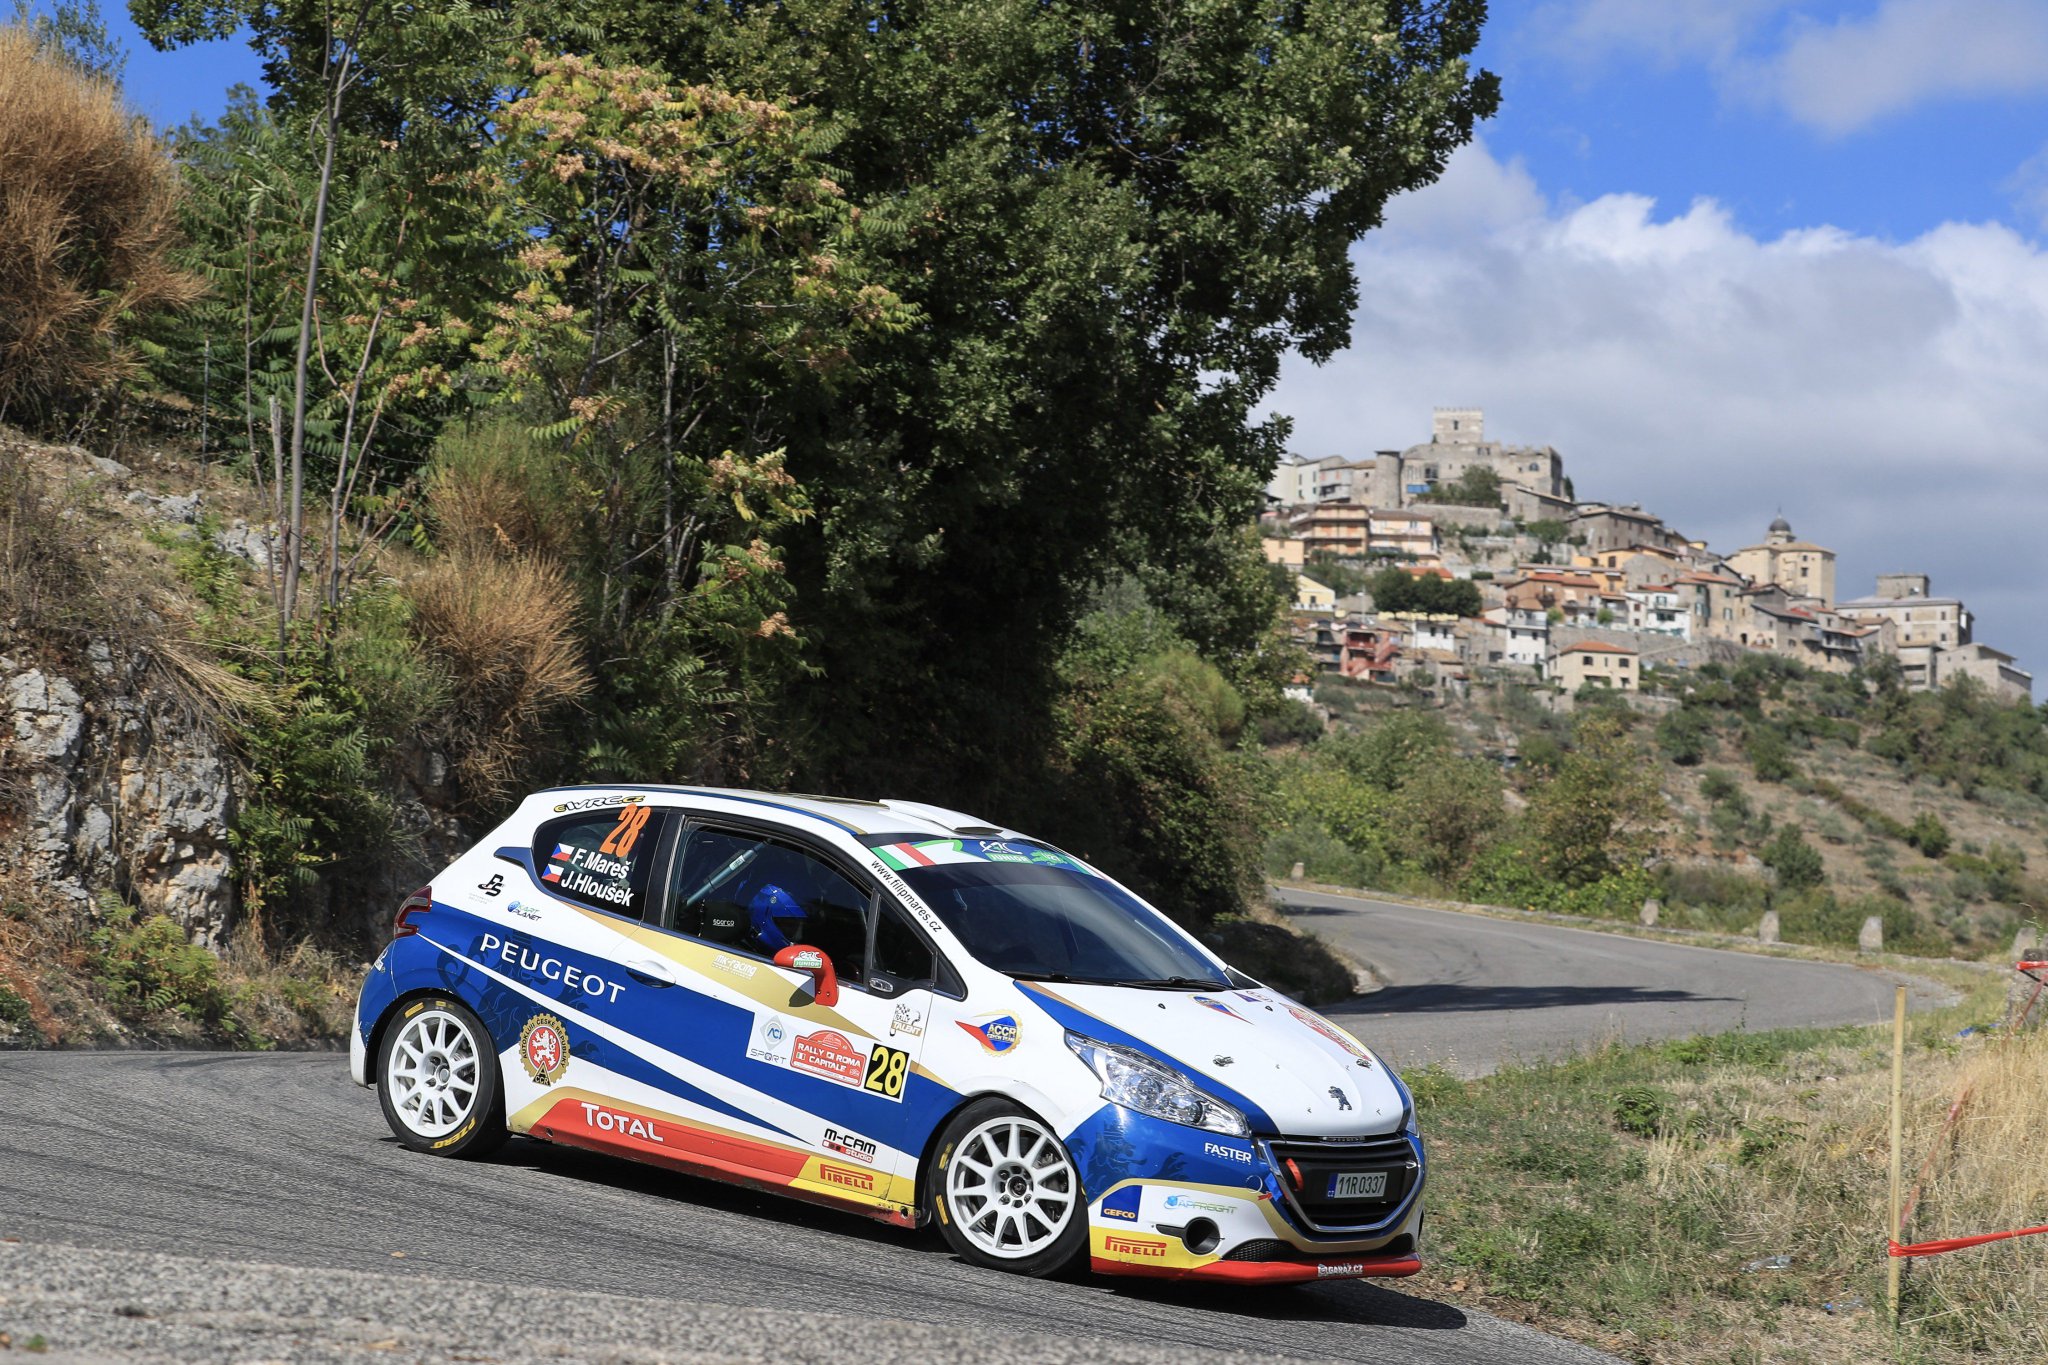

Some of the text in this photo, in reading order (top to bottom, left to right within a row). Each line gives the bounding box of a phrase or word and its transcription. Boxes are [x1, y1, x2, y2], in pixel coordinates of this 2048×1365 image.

[599, 803, 652, 858] 28
[571, 847, 632, 880] F.Mareš
[561, 870, 635, 907] J.Hloušek
[871, 860, 942, 932] www.filipmares.cz
[480, 933, 626, 1003] PEUGEOT
[892, 1021, 921, 1036] TALENT
[987, 1023, 1017, 1039] ACCR
[750, 1048, 787, 1064] SPORT
[797, 1042, 861, 1068] RALLY DI ROMA
[808, 1055, 847, 1073] CAPITALE
[865, 1046, 907, 1097] 28
[580, 1102, 664, 1143] TOTAL
[824, 1128, 877, 1155] M-CAM
[1204, 1142, 1252, 1163] FASTER
[845, 1148, 873, 1163] studio
[820, 1163, 874, 1191] PIRELLI
[1103, 1208, 1137, 1219] GEFCO
[1105, 1236, 1167, 1257] PIRELLI
